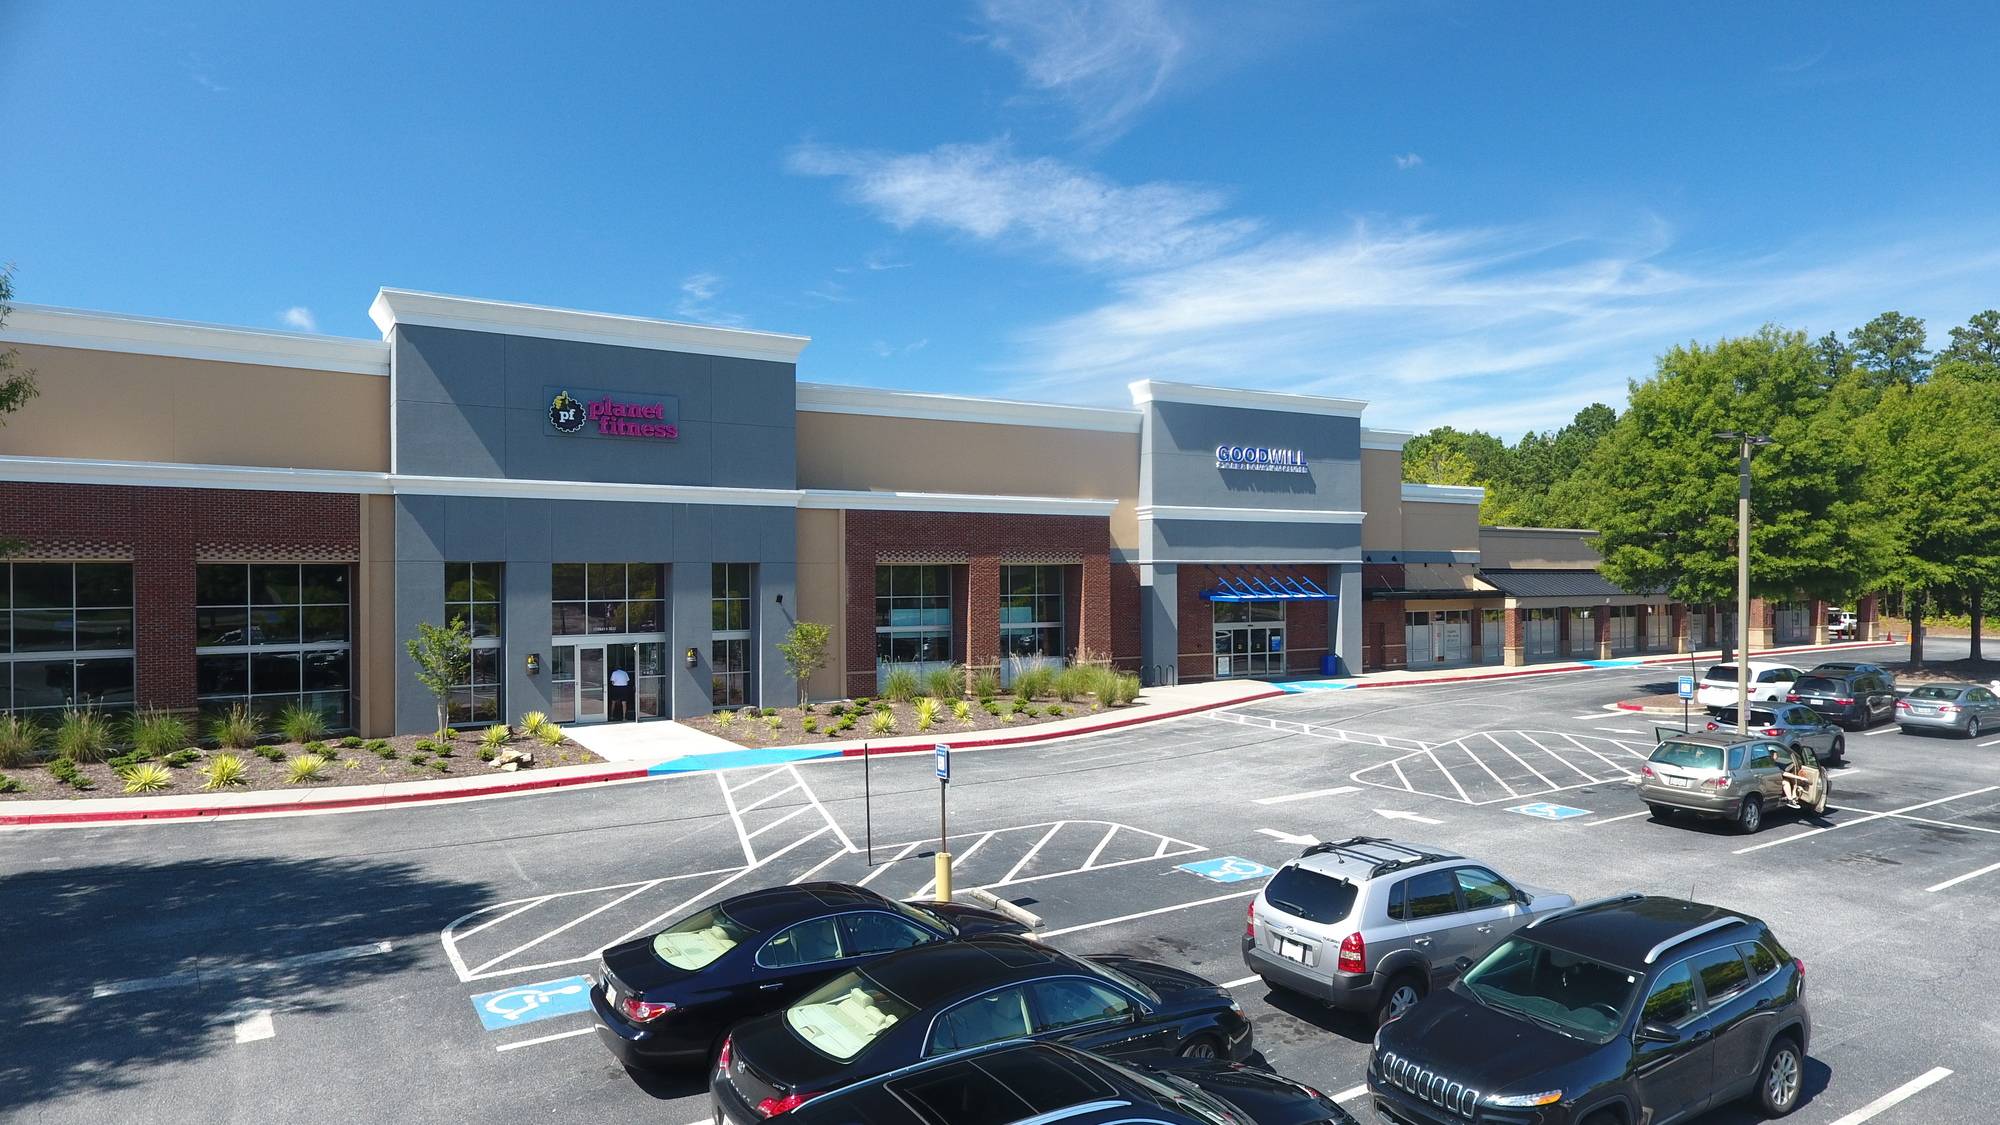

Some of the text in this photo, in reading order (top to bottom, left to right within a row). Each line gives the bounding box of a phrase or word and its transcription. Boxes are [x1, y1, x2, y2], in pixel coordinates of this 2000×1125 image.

[559, 409, 575, 423] pf
[588, 396, 664, 420] planet
[599, 416, 678, 439] fitness
[1216, 446, 1307, 466] GOODWILL
